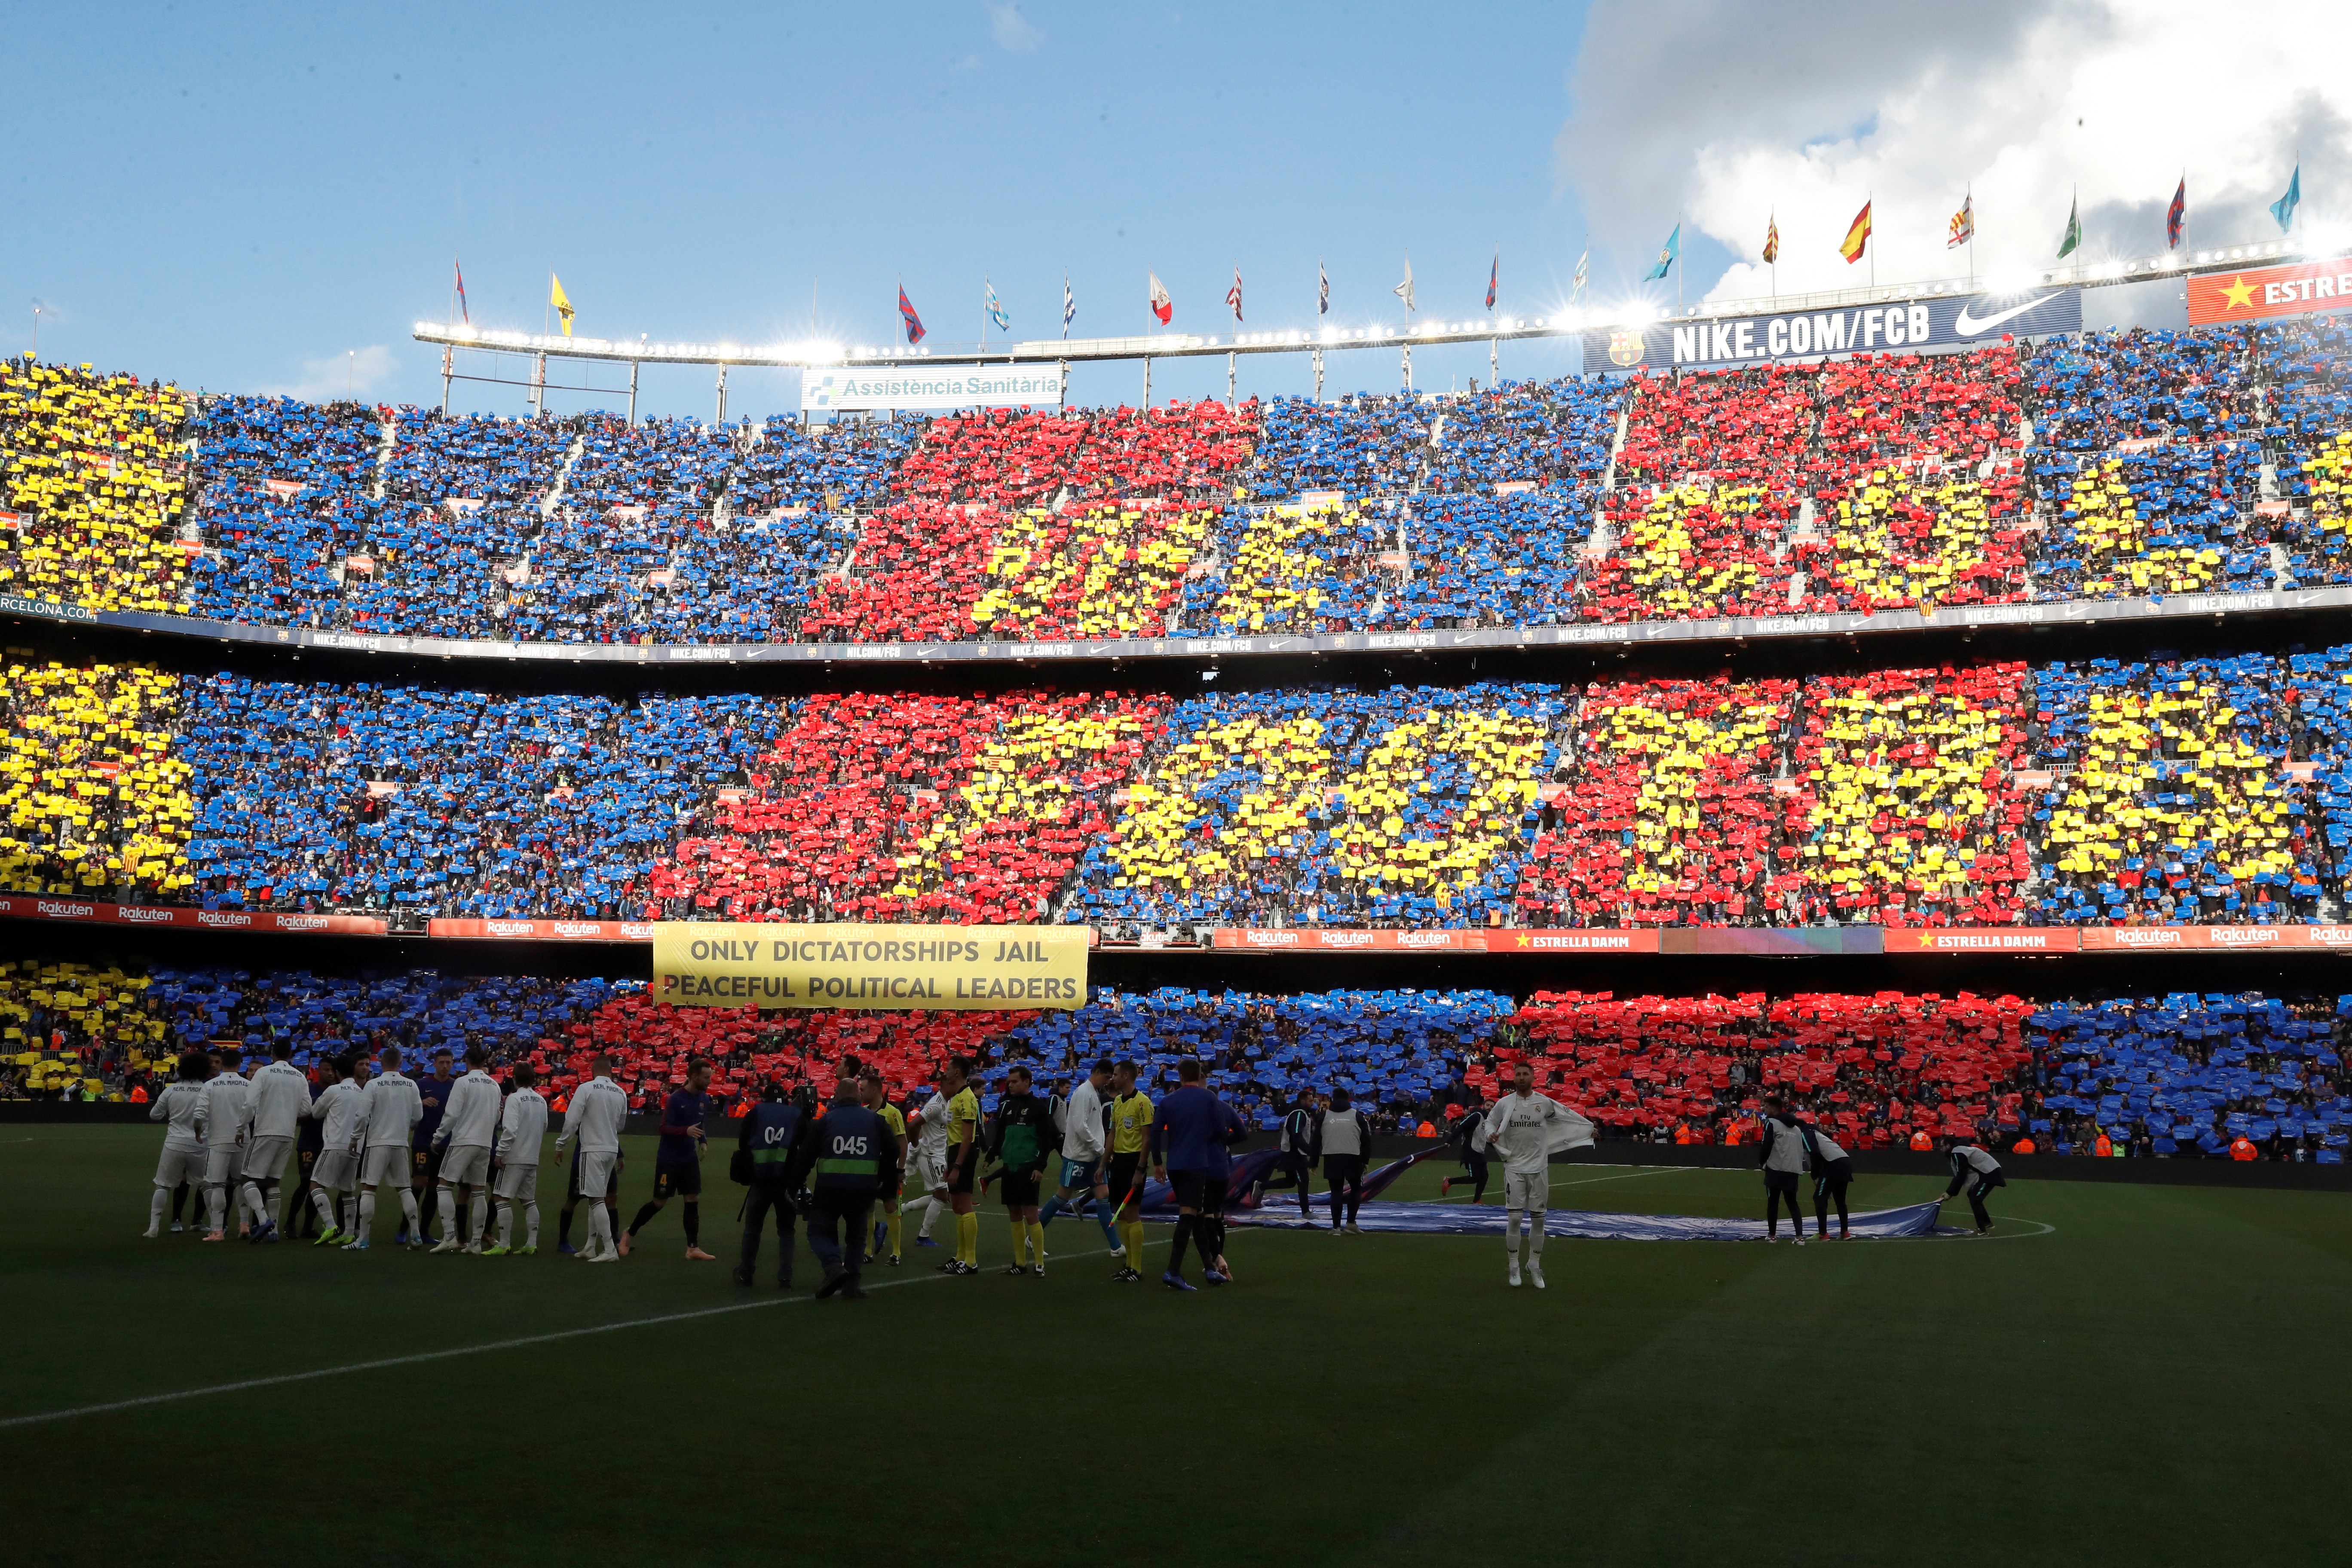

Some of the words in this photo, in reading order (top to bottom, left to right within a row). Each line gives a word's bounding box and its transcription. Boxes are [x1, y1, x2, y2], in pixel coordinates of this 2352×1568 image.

[1673, 305, 1930, 364] NIKE.COM/FCB
[843, 379, 963, 396] Assistència
[967, 377, 1058, 395] Sanitària
[2189, 594, 2273, 611] NIKE.COM/FCB
[1965, 607, 2043, 622] NIKE.COM/FCB
[1756, 618, 1829, 633] NIKE.COM/FCB
[1558, 627, 1628, 641] NIKE.COM/FCB
[313, 634, 380, 649] NIKE.COM/FCB
[1187, 640, 1252, 652] NIKE.COM/FCB
[1369, 634, 1436, 647] NIKE.COM/FCB
[670, 648, 730, 659] NIKE.COM/FCB
[1010, 644, 1073, 656] NIKE.COM/FCB
[38, 901, 93, 916] Rakuten
[119, 907, 173, 921] Rakuten
[198, 912, 251, 925] Rakuten
[276, 916, 328, 927] Rakuten
[487, 922, 533, 933] Rakuten
[554, 922, 600, 934] Rakuten
[689, 925, 736, 937] Rakuten
[758, 926, 805, 937] Rakuten
[827, 926, 873, 937] Rakuten
[897, 927, 944, 938] Rakuten
[967, 927, 1015, 939] Rakuten
[1037, 928, 1085, 939] Rakuten
[1247, 931, 1298, 943] Rakuten
[1322, 931, 1373, 943] Rakuten
[1397, 932, 1450, 944] Rakuten
[2115, 928, 2180, 943] Rakuten
[2211, 928, 2278, 941] Rakuten
[1533, 937, 1589, 947] ESTRELLA
[1592, 937, 1629, 947] DAMM
[1938, 936, 2001, 947] ESTRELLA
[2003, 936, 2046, 947] DAMM
[691, 940, 760, 962] ONLY
[773, 940, 979, 962] DICTATORSHIPS
[993, 941, 1049, 962] JAIL
[664, 974, 796, 998] PEACEFUL
[808, 977, 942, 999] POLITICAL
[956, 977, 1076, 999] LEADERS
[283, 1069, 302, 1078] MADRID
[833, 1135, 867, 1155] 045
[302, 1151, 313, 1162] 12
[415, 1152, 427, 1165] 15
[1072, 1165, 1084, 1177] 25
[660, 1173, 668, 1186] 4
